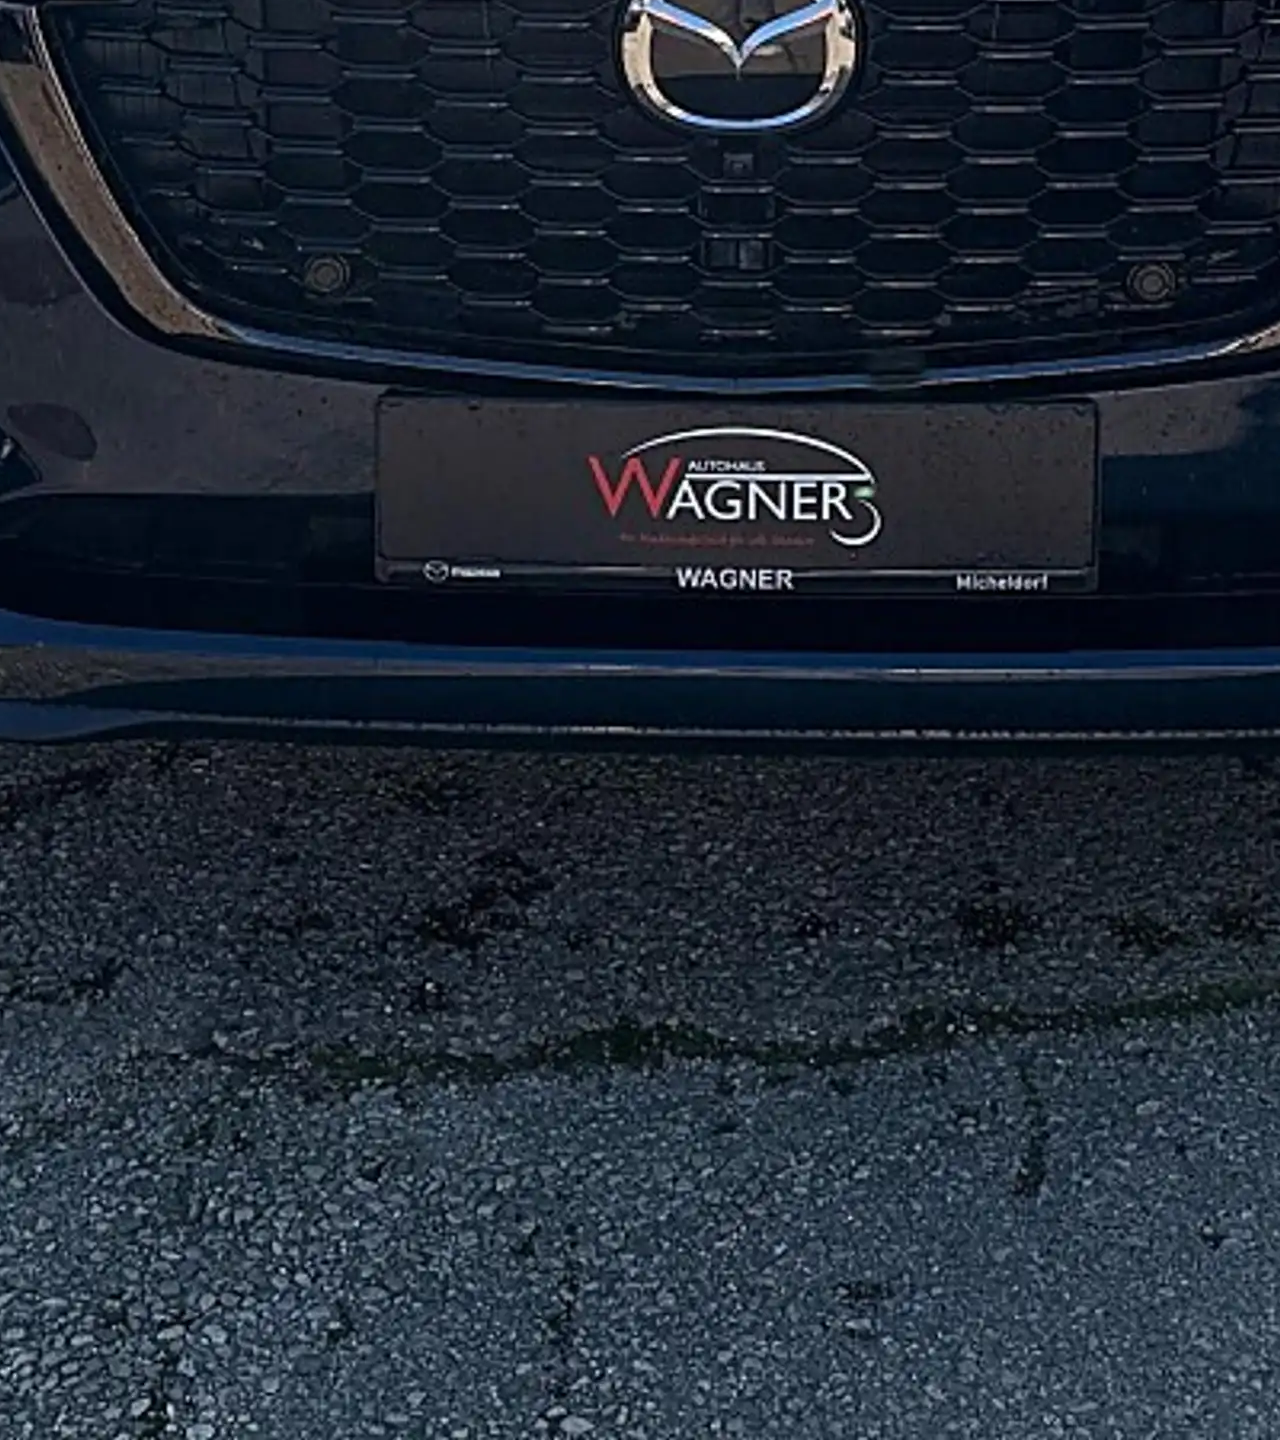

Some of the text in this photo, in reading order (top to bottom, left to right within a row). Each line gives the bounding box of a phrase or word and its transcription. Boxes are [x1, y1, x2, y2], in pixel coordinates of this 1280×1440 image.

[688, 460, 766, 472] AUTOHAUS
[587, 456, 853, 520] WAGNER
[676, 567, 794, 590] WAGNER
[956, 574, 1048, 591] Micheldorf
